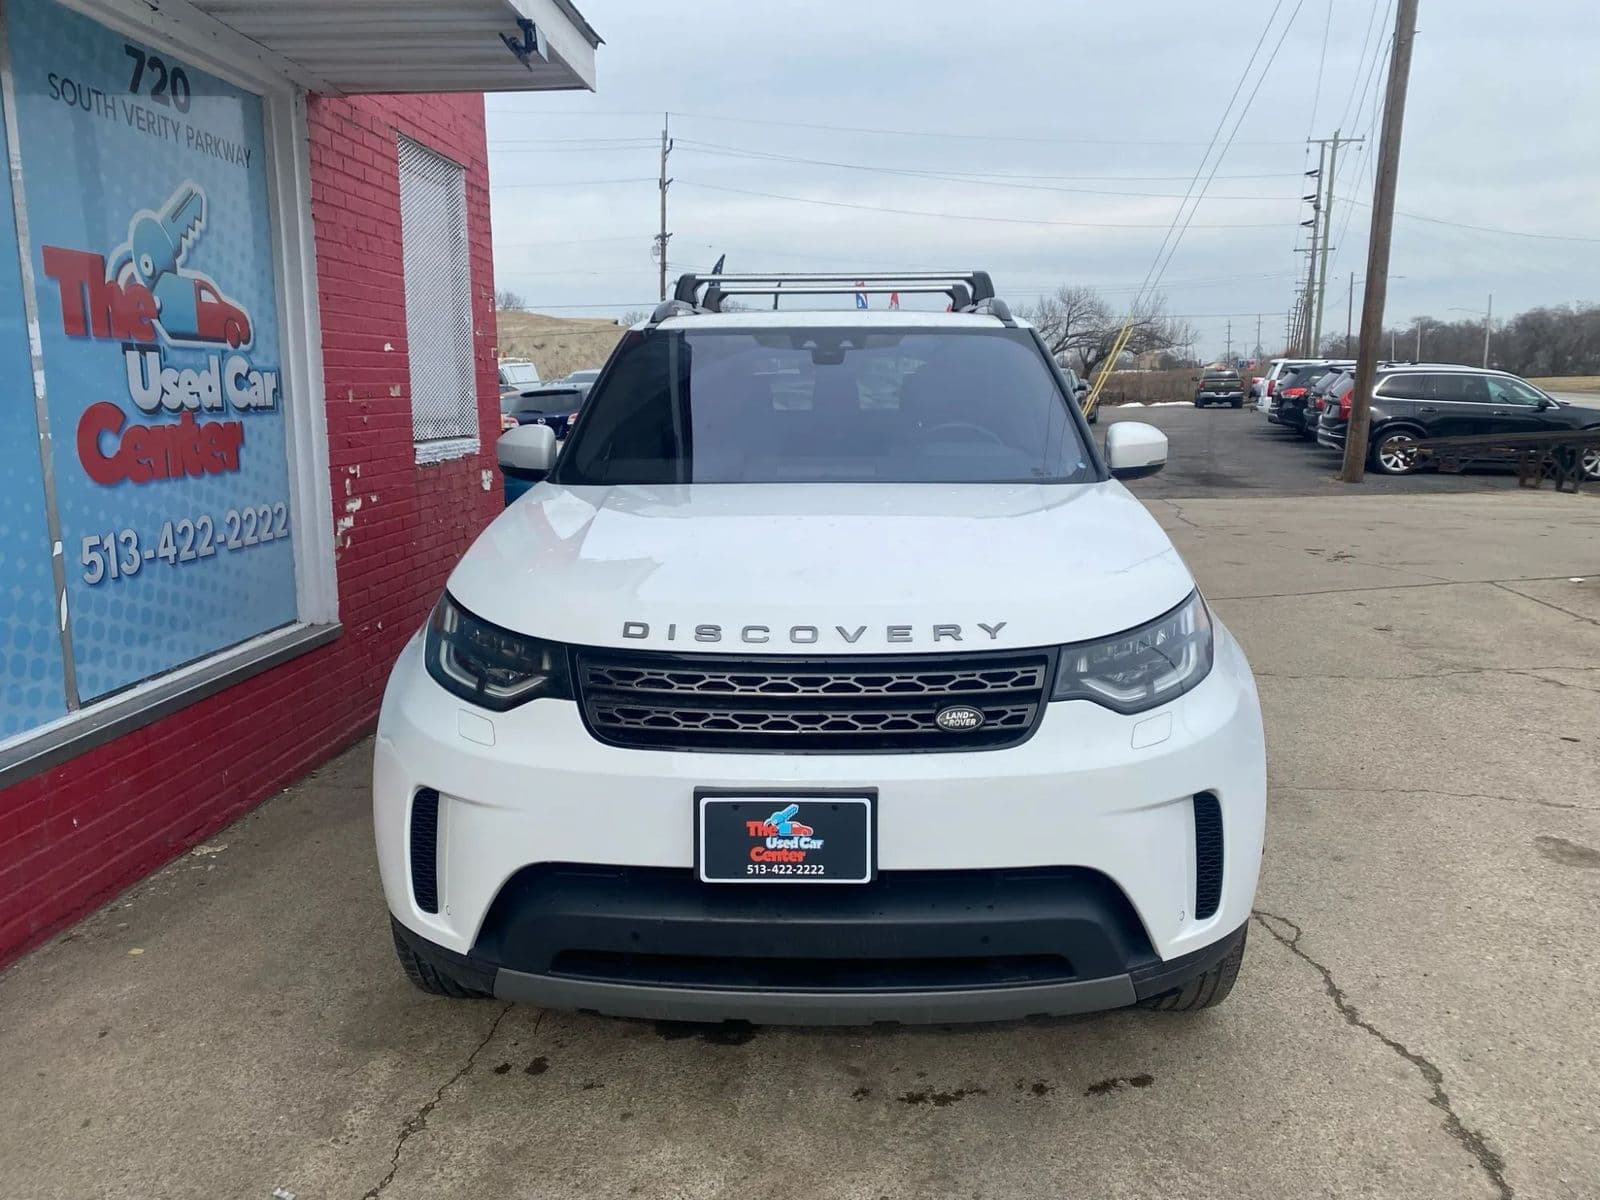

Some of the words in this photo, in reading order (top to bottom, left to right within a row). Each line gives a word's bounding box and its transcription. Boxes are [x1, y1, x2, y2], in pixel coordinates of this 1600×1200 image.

[124, 44, 191, 114] 720
[48, 72, 117, 121] SOUTH
[122, 106, 181, 144] VERITY
[186, 127, 250, 169] PARKWAY
[41, 245, 157, 341] The
[124, 349, 223, 413] Used
[224, 354, 278, 410] Car
[76, 401, 243, 486] Center
[81, 501, 289, 585] 513-422-2222
[622, 620, 1008, 644] DISCOVERY
[746, 821, 777, 837] The
[750, 846, 806, 862] Center
[765, 836, 799, 849] Used
[799, 836, 824, 849] Car
[746, 864, 825, 875] 513-422-2222
